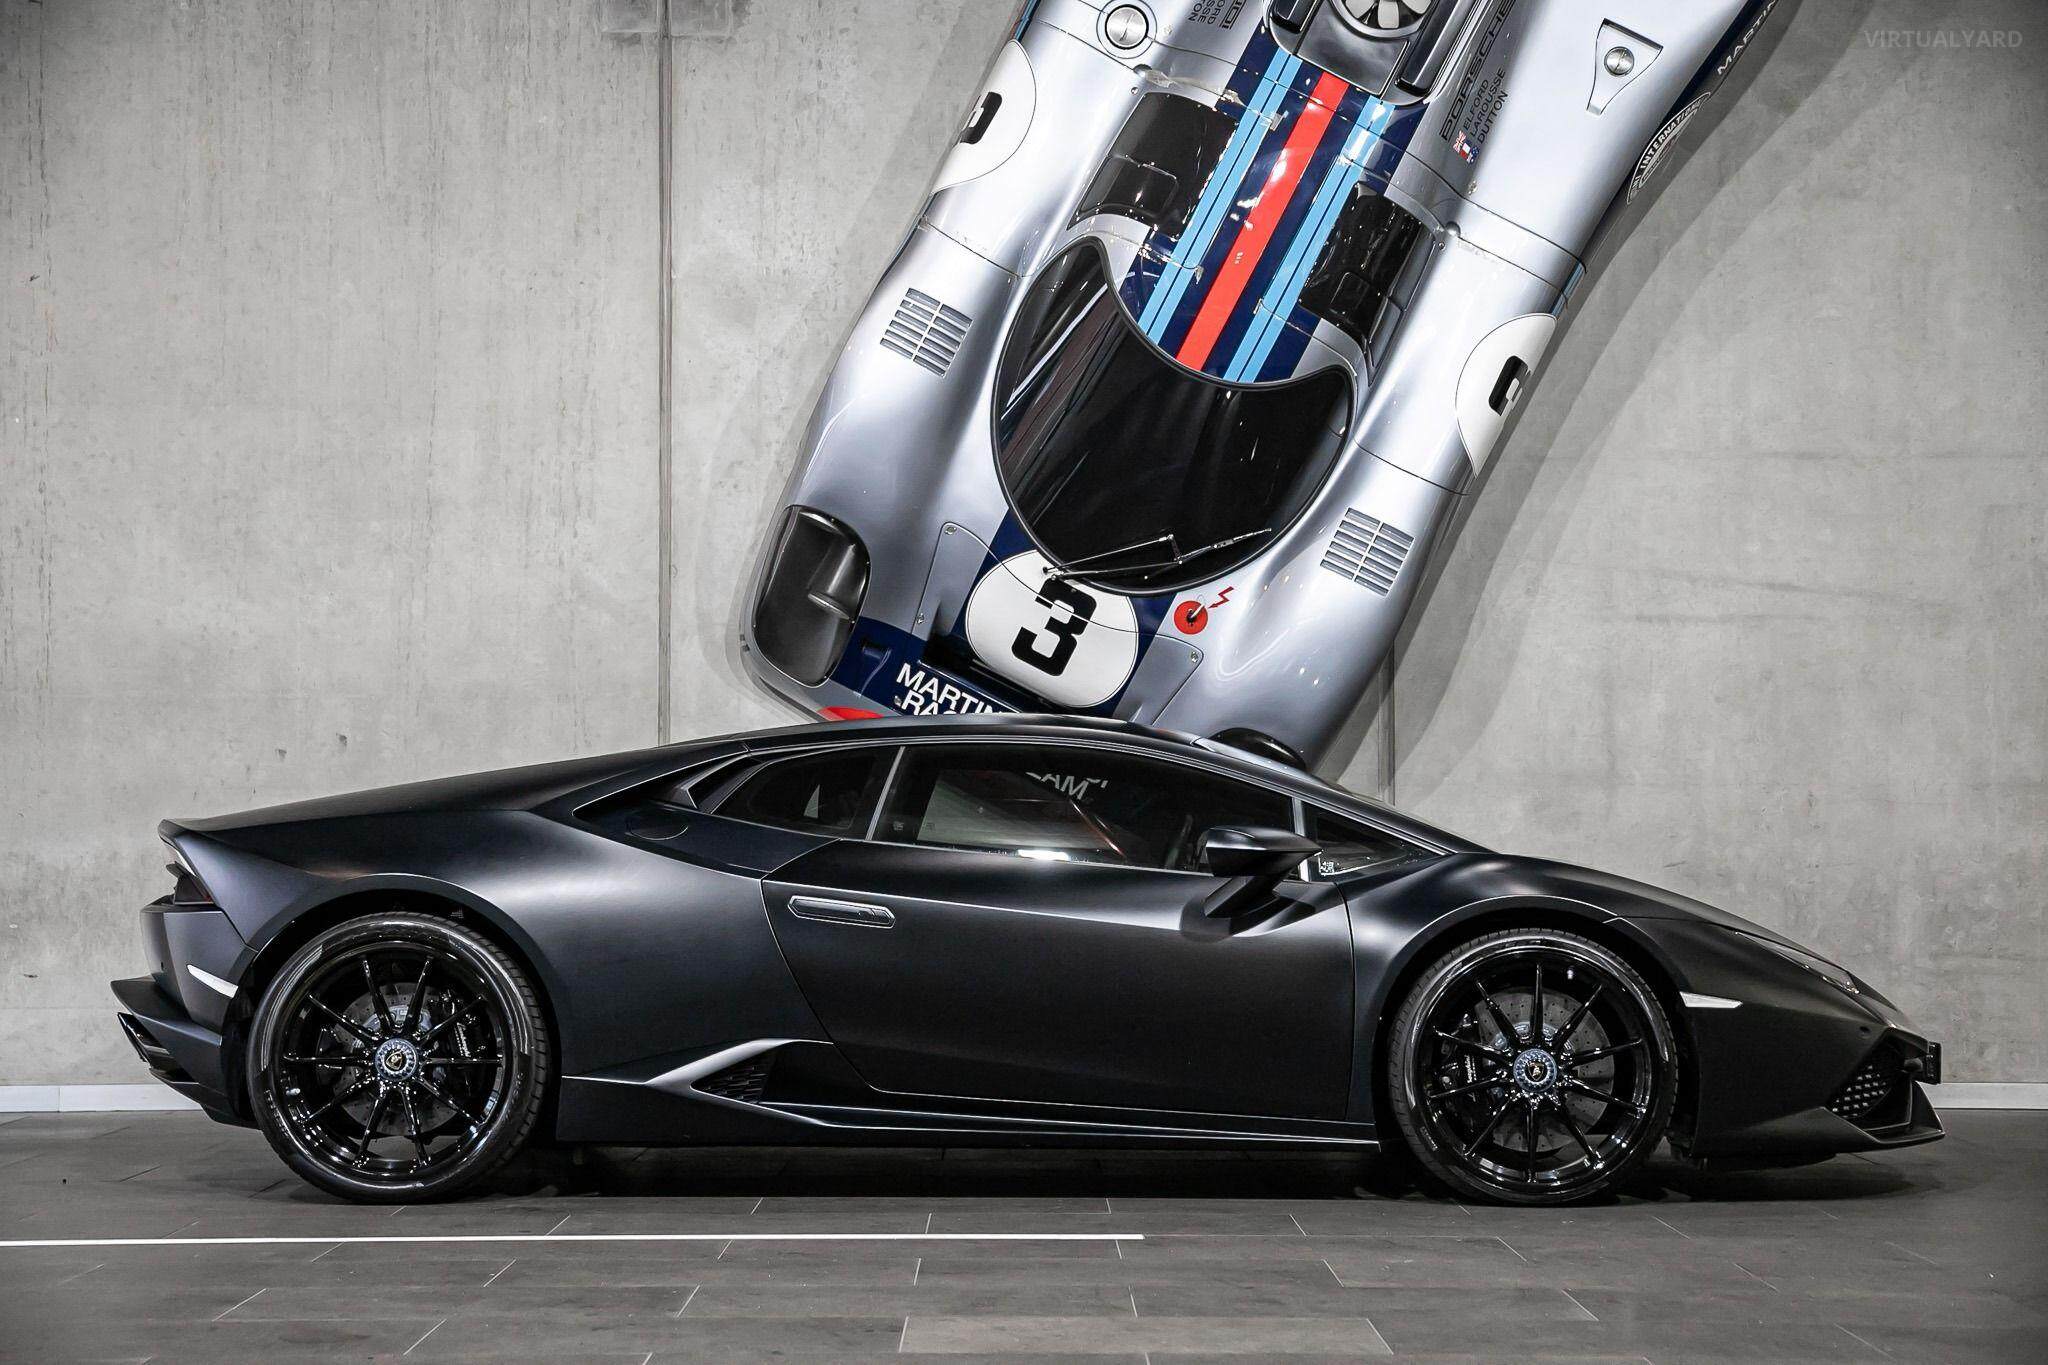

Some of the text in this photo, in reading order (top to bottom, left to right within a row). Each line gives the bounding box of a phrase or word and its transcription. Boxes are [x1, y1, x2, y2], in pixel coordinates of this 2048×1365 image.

[1188, 0, 1206, 21] ON
[1440, 0, 1515, 141] PORSCHE
[1463, 79, 1489, 131] ELFORD
[1470, 68, 1506, 137] LAROUSSE
[1477, 90, 1509, 144] DUTTON
[1011, 575, 1097, 677] 3
